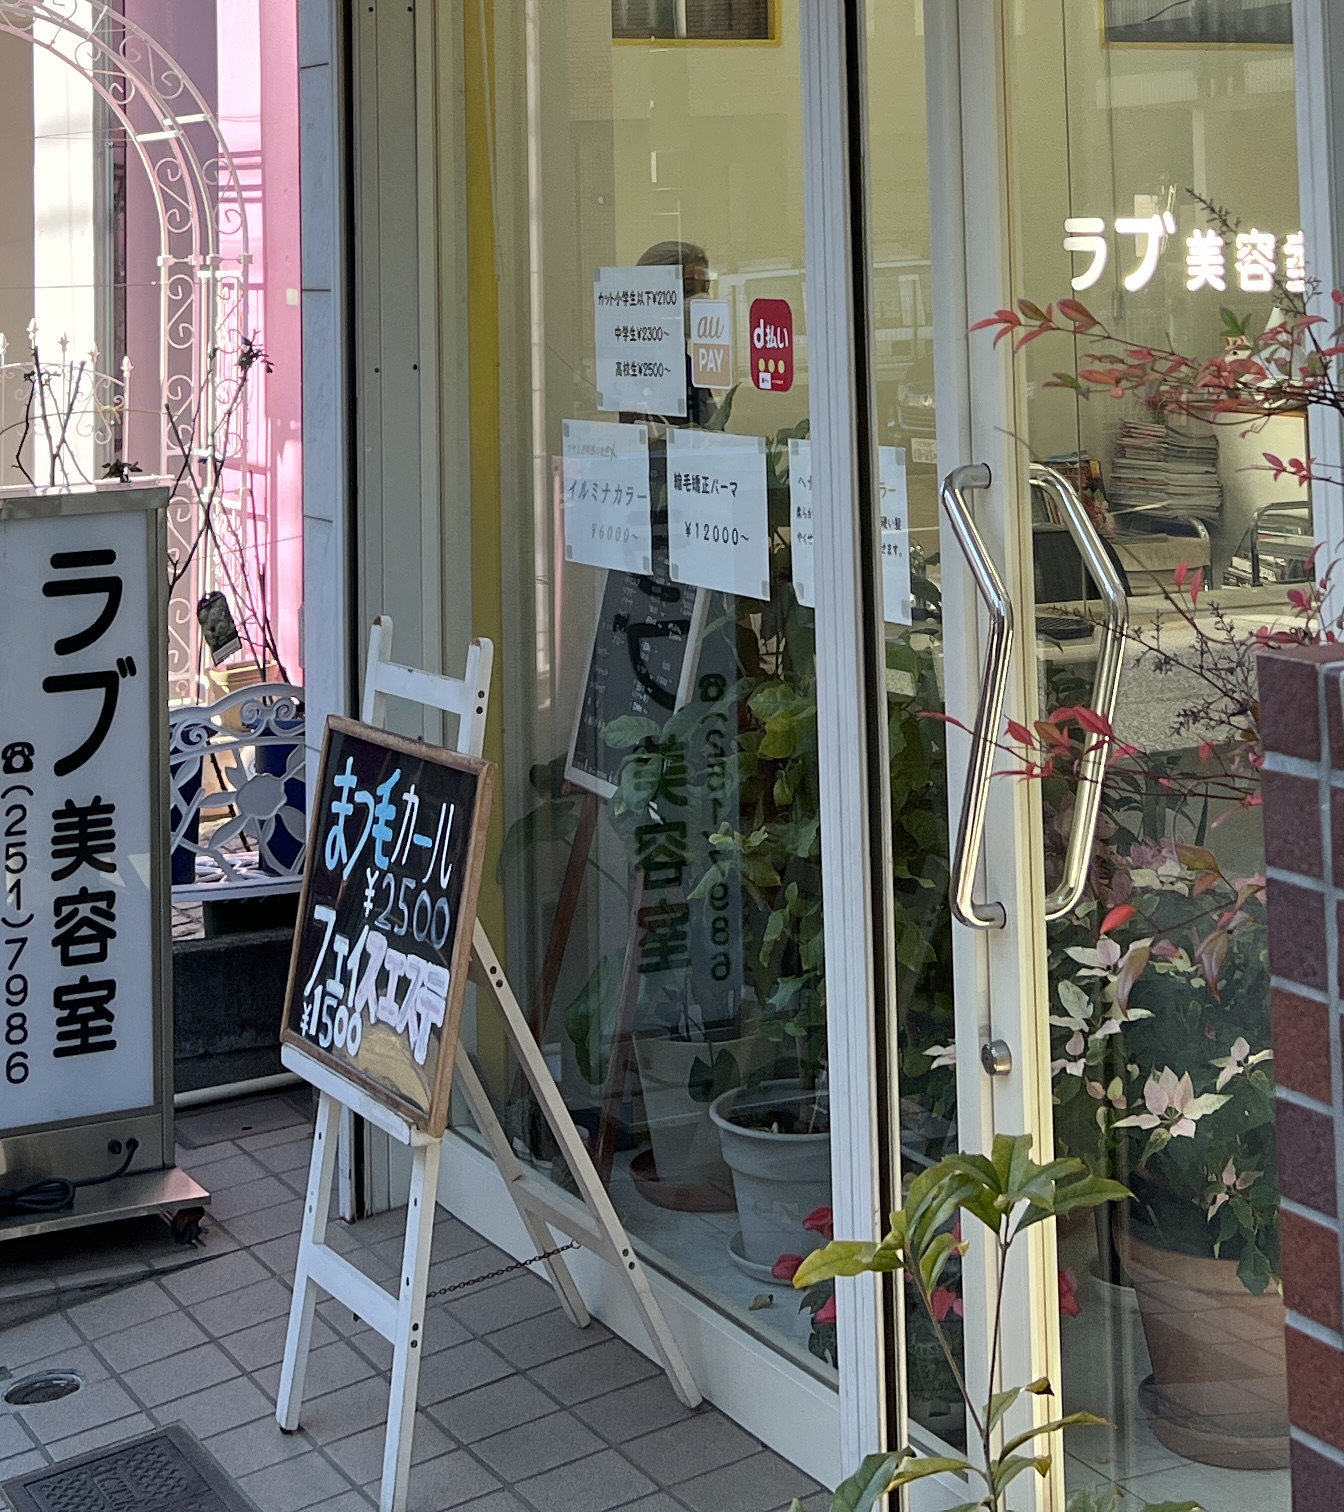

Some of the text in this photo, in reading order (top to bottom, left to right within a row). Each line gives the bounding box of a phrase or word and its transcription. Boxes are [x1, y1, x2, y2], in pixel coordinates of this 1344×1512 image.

[697, 316, 725, 339] au
[753, 318, 789, 349] d払い
[698, 348, 724, 373] PAY
[569, 480, 647, 506] イルミナカラー
[42, 548, 136, 1058] ラブ美容室
[325, 756, 455, 889] まつ毛カール
[363, 867, 451, 950] ¥2500
[300, 985, 363, 1056] ¥1500
